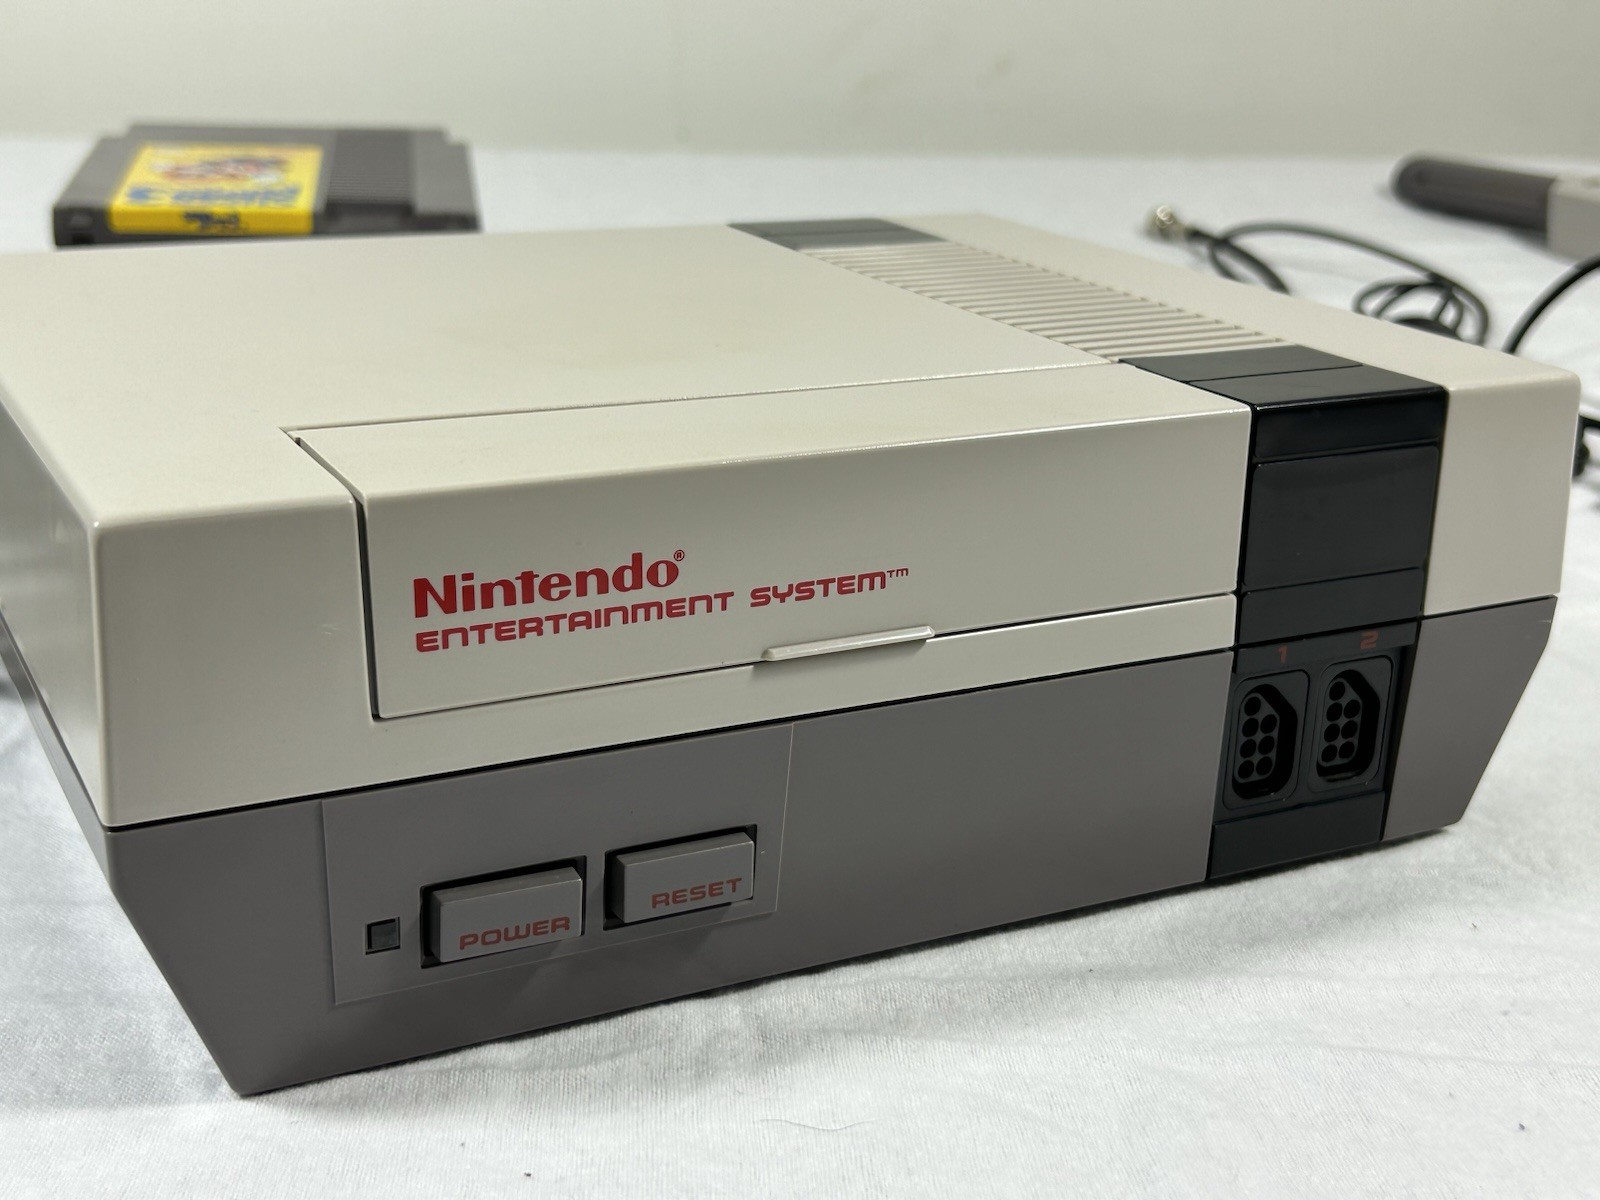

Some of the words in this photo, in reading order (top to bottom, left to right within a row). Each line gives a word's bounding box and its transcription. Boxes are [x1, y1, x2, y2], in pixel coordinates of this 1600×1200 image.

[414, 591, 735, 653] ENTERTAINMENT
[1277, 645, 1288, 664] 1
[1360, 630, 1379, 649] 2
[651, 877, 743, 909] RESET
[459, 916, 571, 950] POWER
